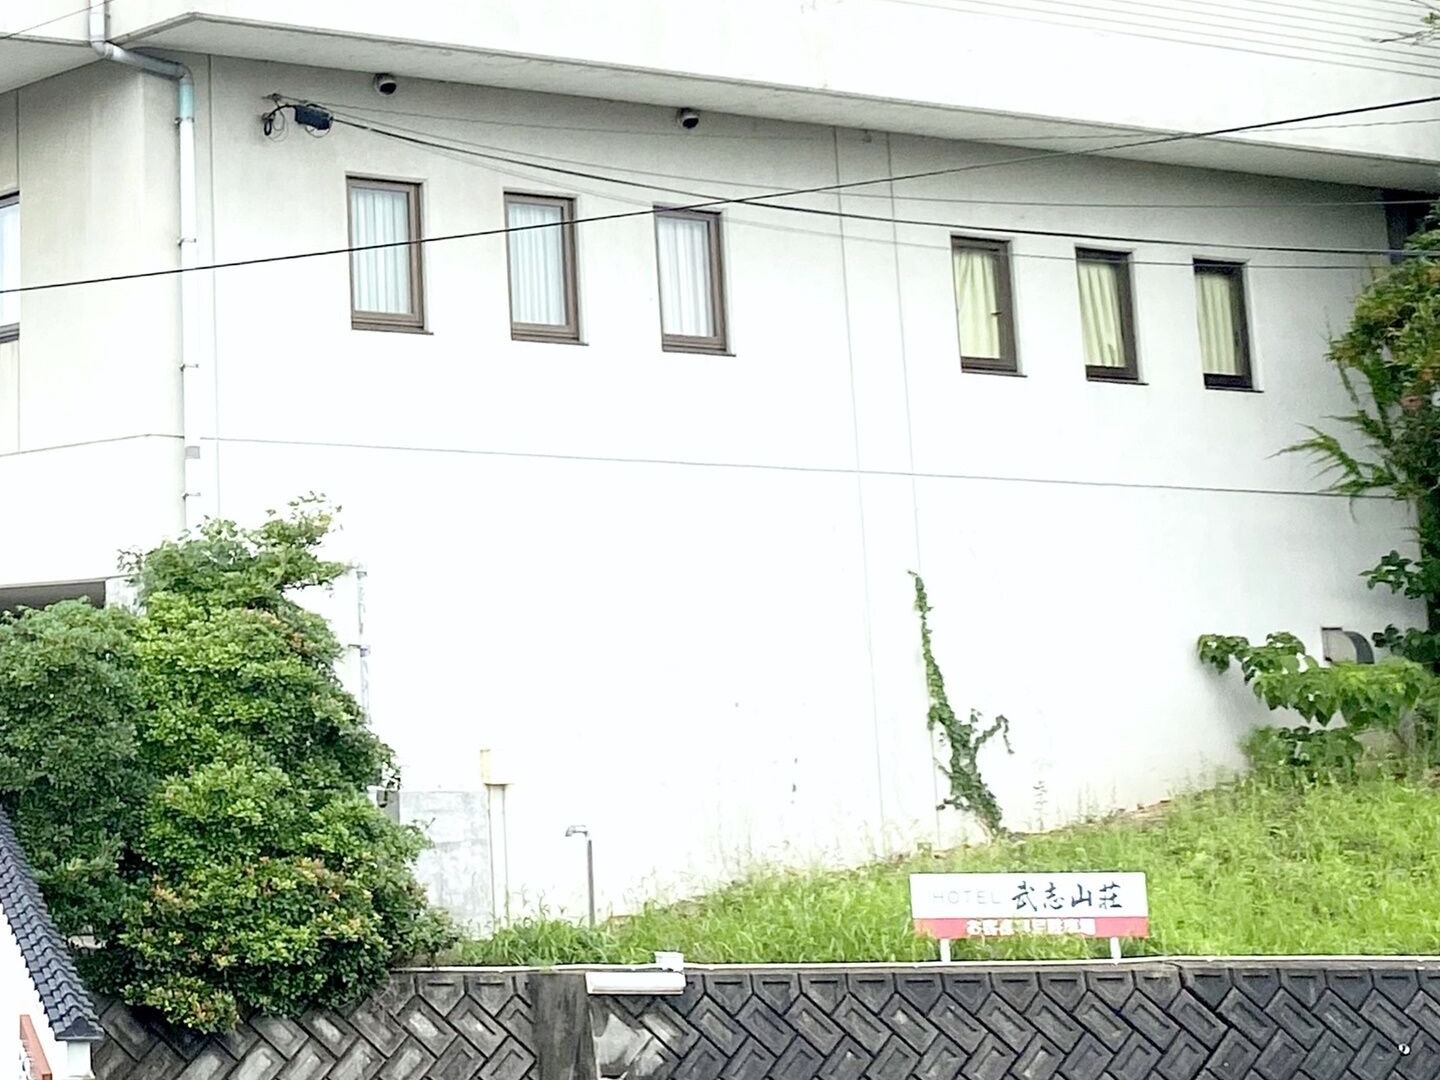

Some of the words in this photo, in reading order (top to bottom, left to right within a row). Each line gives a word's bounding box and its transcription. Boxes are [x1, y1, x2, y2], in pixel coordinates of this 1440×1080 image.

[932, 890, 1002, 906] HOTEL
[1011, 880, 1123, 912] 武志山荘
